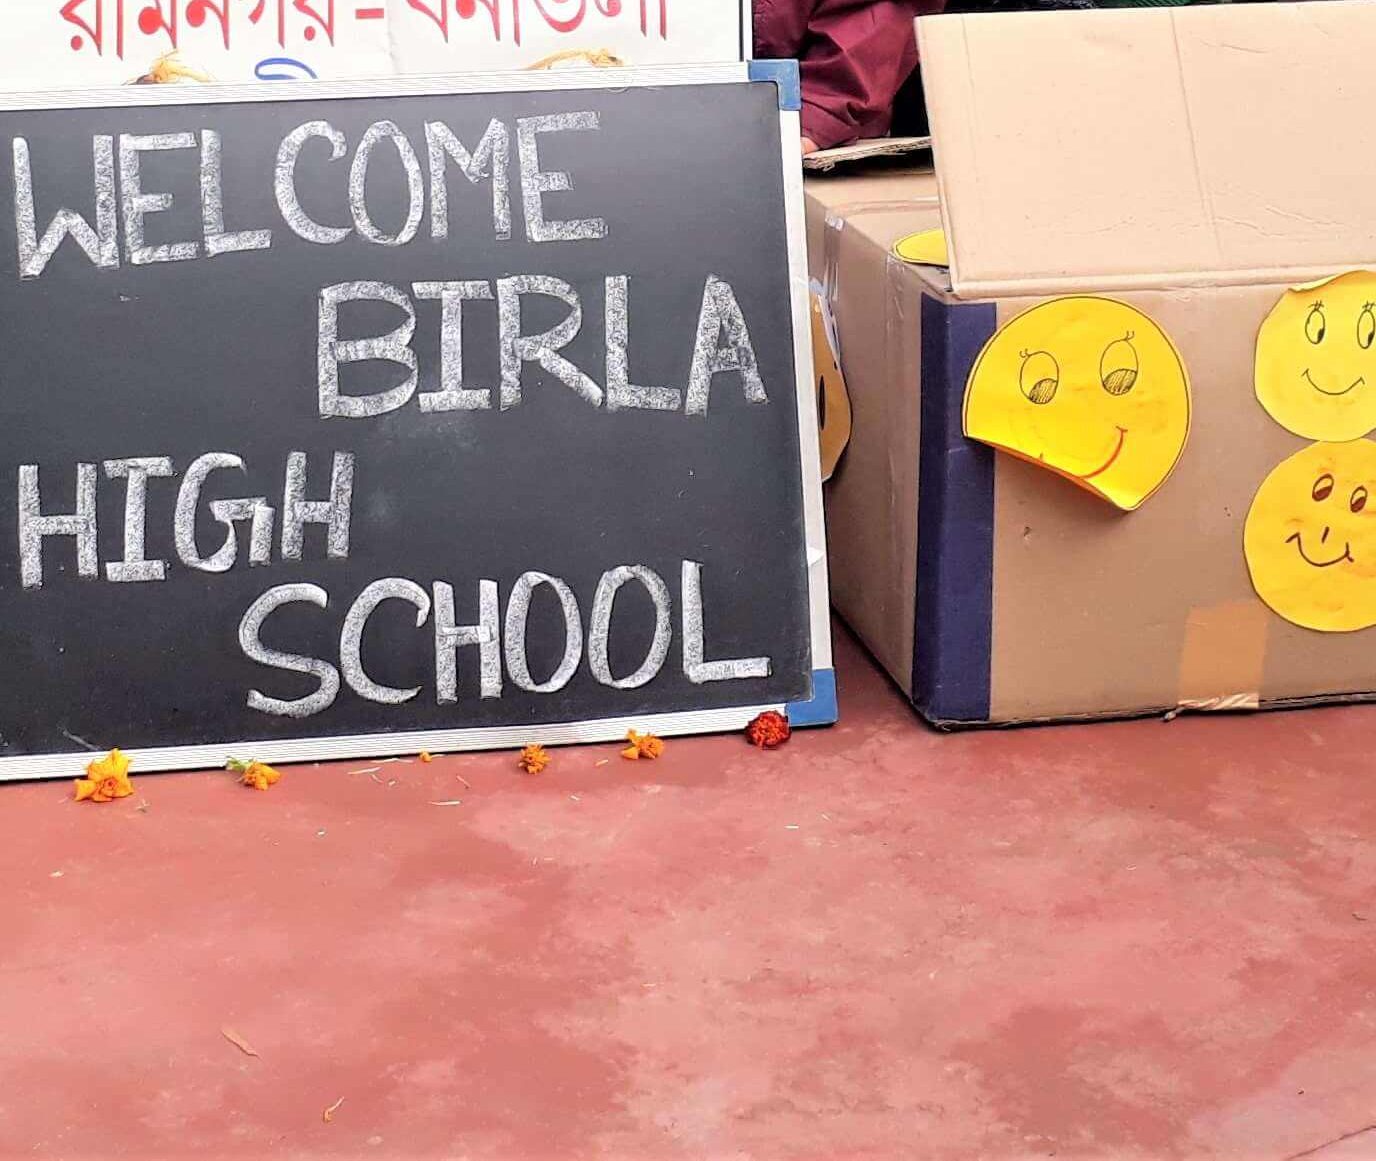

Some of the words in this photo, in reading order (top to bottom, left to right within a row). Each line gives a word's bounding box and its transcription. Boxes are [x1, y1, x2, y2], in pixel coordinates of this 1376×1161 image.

[13, 111, 609, 280] WELCOME
[317, 275, 770, 418] BIRLA
[17, 451, 356, 590] HIGH
[238, 560, 773, 718] SCHOOL
